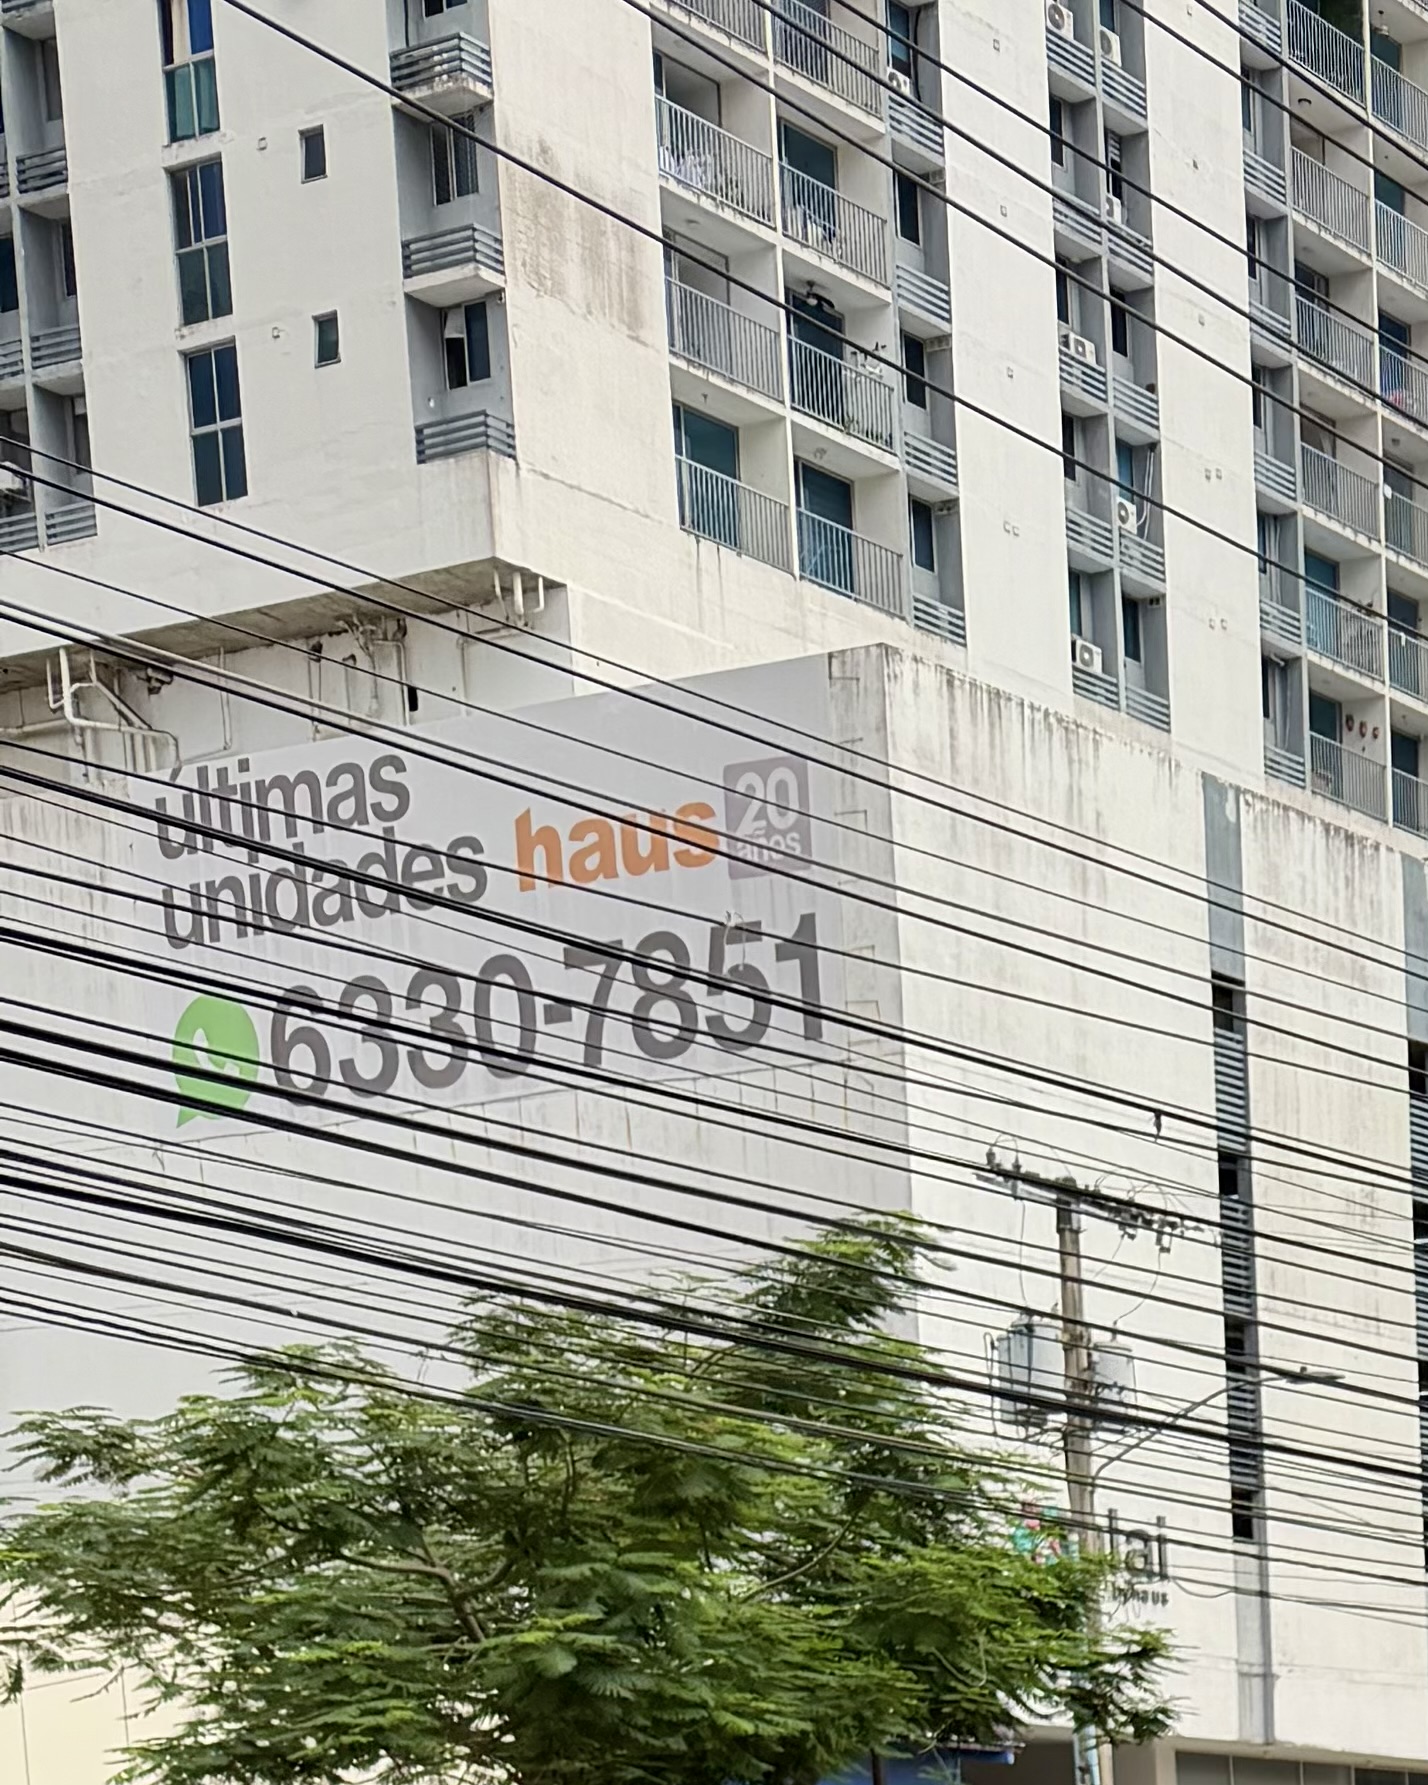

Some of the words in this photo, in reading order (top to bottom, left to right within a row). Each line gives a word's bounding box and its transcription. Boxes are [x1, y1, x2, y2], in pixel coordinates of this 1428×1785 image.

[155, 753, 410, 860] últimas
[735, 766, 799, 834] 20
[162, 826, 488, 950] unidades
[514, 801, 720, 893] haus
[270, 912, 826, 1108] 6330-7851
